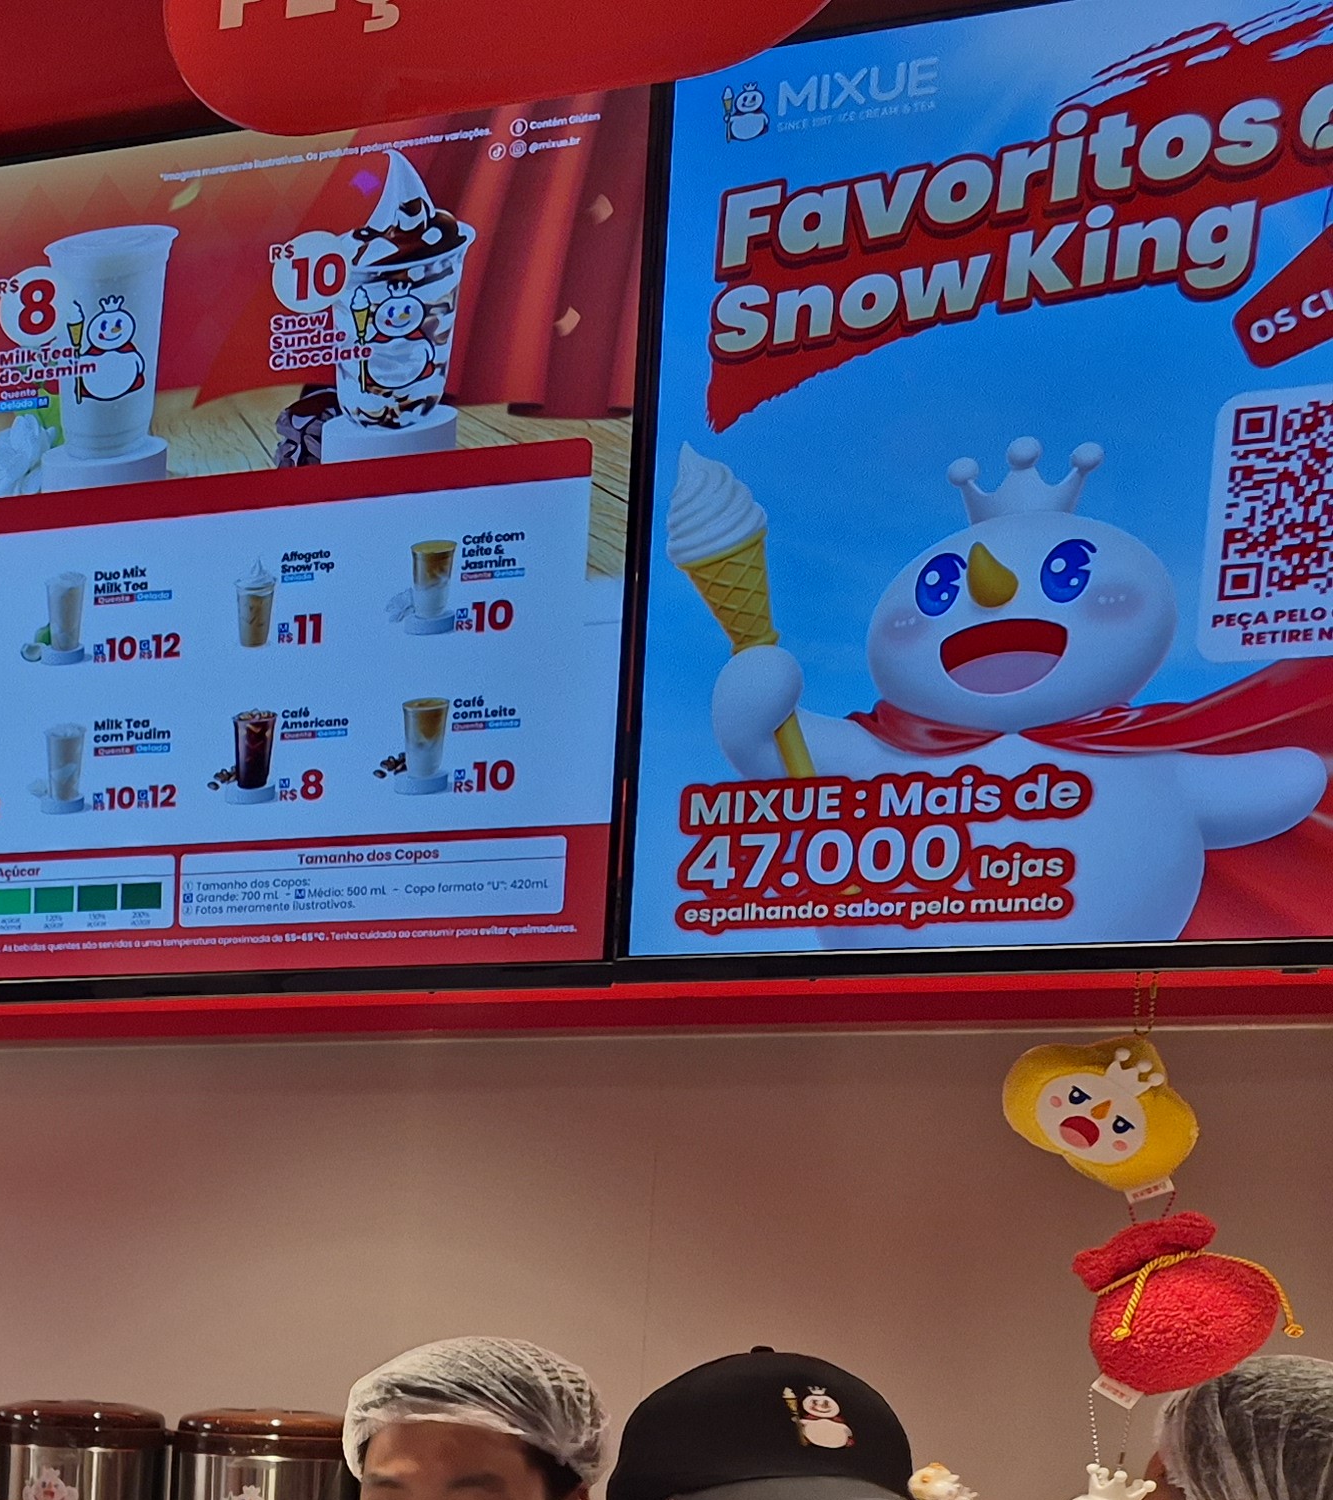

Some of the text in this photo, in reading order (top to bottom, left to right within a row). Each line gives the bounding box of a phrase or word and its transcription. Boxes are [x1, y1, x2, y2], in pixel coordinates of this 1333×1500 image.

[778, 57, 940, 116] MIXUE
[721, 98, 1281, 268] Favoritos
[291, 252, 348, 301] 10
[715, 199, 1257, 353] Snow King
[18, 278, 56, 336] 8
[271, 313, 328, 332] Snow
[1249, 306, 1297, 344] OS
[271, 329, 348, 351] Sundae
[40, 347, 74, 362] Tea
[270, 344, 373, 370] Chocolate
[23, 360, 98, 382] Jasmim
[462, 531, 525, 545] Café com
[281, 550, 331, 563] Affogato
[461, 545, 505, 558] Leite &
[281, 561, 335, 574] Snow Top
[461, 556, 516, 570] Jasmim
[94, 566, 147, 582] Duo Mix
[94, 580, 148, 595] Milk Tea
[472, 600, 514, 632] 10
[1211, 606, 1327, 631] PEÇA PELO
[293, 614, 322, 644] 11
[1241, 628, 1313, 646] RETIRE
[453, 696, 484, 708] Café
[281, 708, 310, 719] Café
[452, 706, 516, 720] com Leite
[94, 718, 150, 731] Milk Tea
[281, 716, 349, 731] Americano
[93, 728, 171, 743] com Pudim
[300, 769, 323, 800] 8
[473, 760, 515, 792] 10
[689, 772, 1083, 826] MIXUE Mais de
[297, 847, 440, 866] Tamanho dos Copos
[686, 823, 1065, 890] 47.000 lojas
[683, 891, 1065, 927] espalhando sabor pelo mundo
